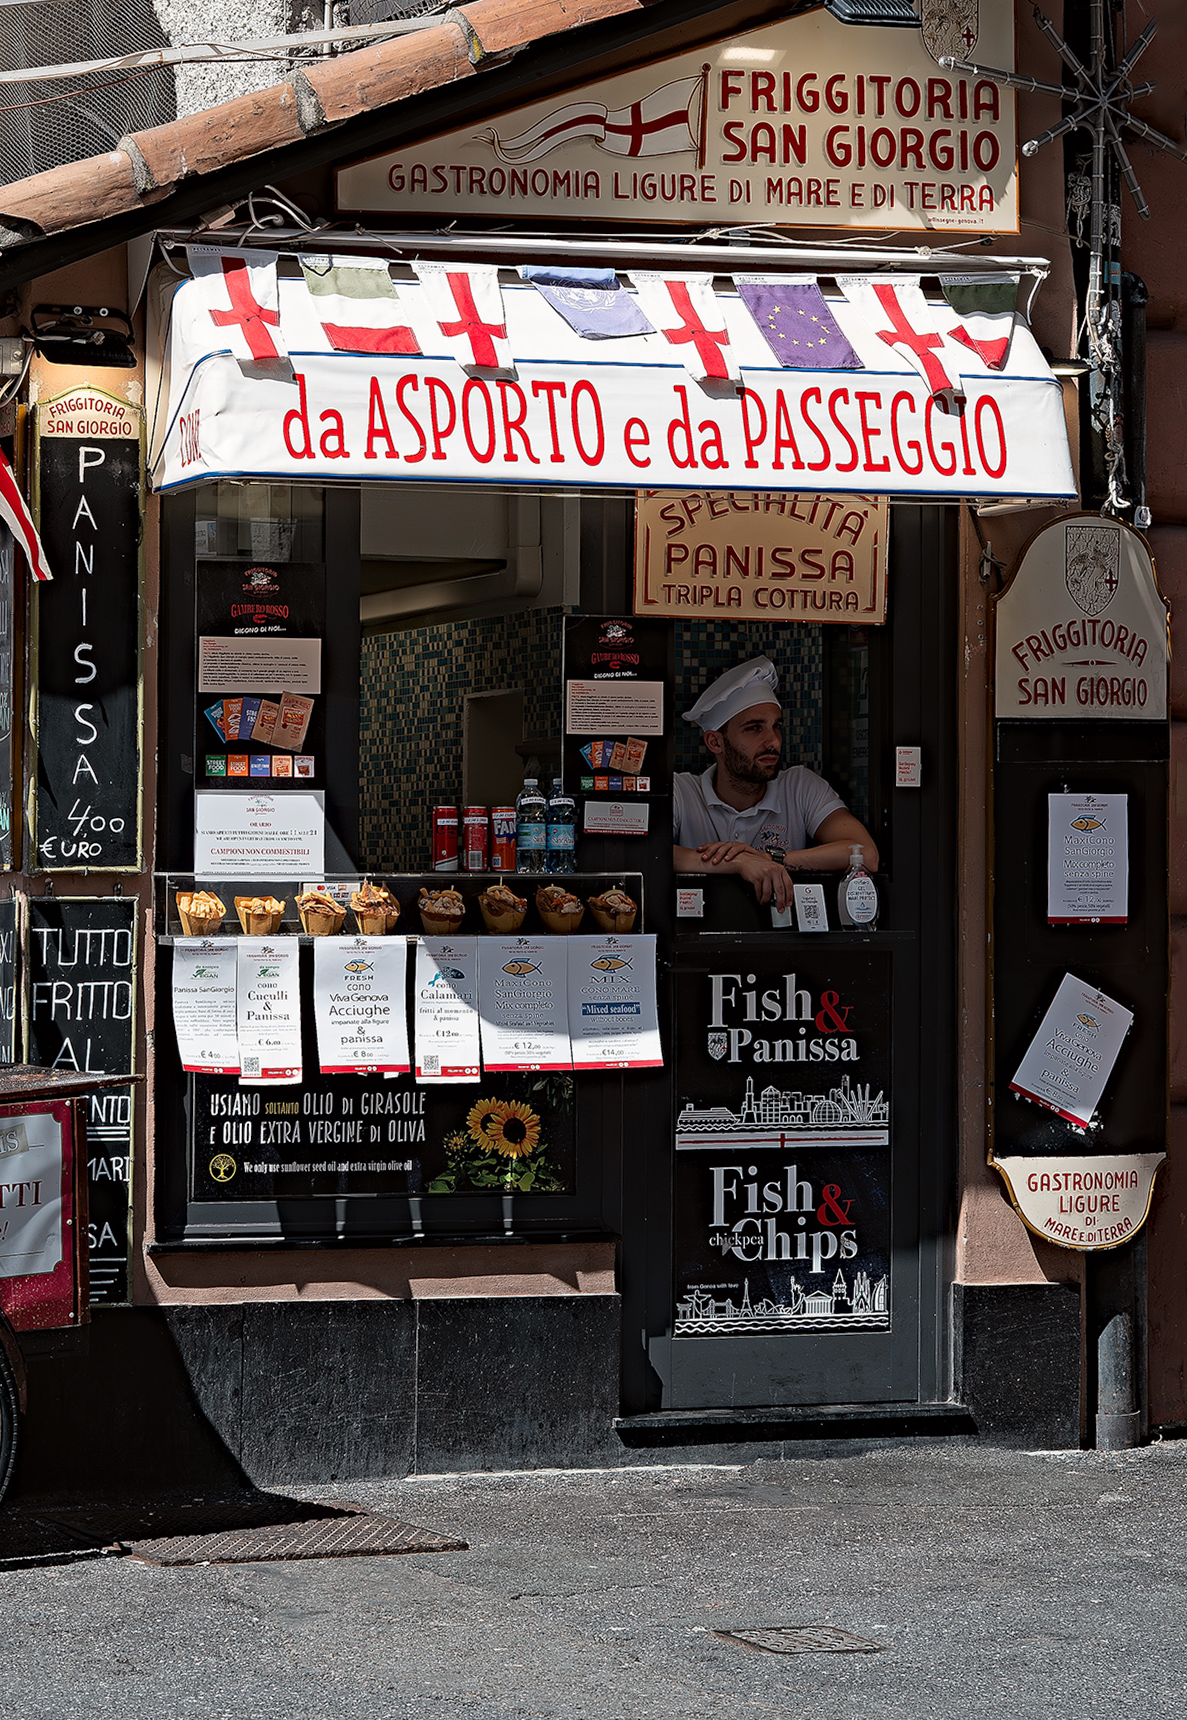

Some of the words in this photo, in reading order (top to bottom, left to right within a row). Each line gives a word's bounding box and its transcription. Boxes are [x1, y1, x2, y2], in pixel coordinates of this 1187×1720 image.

[720, 69, 1001, 122] FRIGGITORIA
[721, 121, 808, 165] SAN
[825, 124, 1001, 173] GIORGIO
[388, 163, 601, 199] GASTRONOMIA
[614, 171, 717, 203] LIGURE
[729, 177, 752, 204] DI
[766, 177, 841, 207] MARE
[851, 182, 865, 207] E
[873, 182, 896, 209] DI
[906, 181, 996, 212] TERRA
[49, 397, 126, 419] FRIGGITORIA
[47, 420, 74, 434] SAN
[77, 421, 132, 435] GIORGIO
[282, 373, 350, 459] da
[364, 373, 605, 467] ASPORTO
[623, 417, 652, 468] e
[667, 385, 729, 469] da
[738, 386, 1007, 478] PASSEGGIO
[659, 491, 869, 546] SPECIALITÀ
[664, 543, 855, 581] PANISSA
[662, 584, 743, 607] TRIPLA
[754, 587, 859, 611] COTTURA
[231, 604, 265, 618] GAMBERO
[266, 604, 289, 619] ROSSO
[1011, 619, 1148, 672] FRIGGITORIA
[591, 652, 620, 665] GAMBERO
[621, 653, 640, 666] ROSSO
[1017, 676, 1066, 705] SAN
[1076, 676, 1148, 707] GIORGIO
[1064, 836, 1115, 845] MaxiCono
[261, 848, 310, 856] COMMESTIBILI
[1064, 847, 1114, 857] SanGiorgio
[31, 928, 133, 966] TUTTO
[347, 983, 371, 991] cono
[494, 979, 552, 987] MaxiCono
[590, 975, 632, 984] MIX
[199, 986, 235, 994] SanGiorgio
[247, 990, 288, 1001] Cuculli
[329, 993, 350, 1002] Viva
[350, 993, 389, 1002] Genova
[420, 989, 472, 1000] Calamari
[494, 989, 553, 1000] SanGiorgio
[32, 982, 133, 1020] FRITTO
[263, 1001, 272, 1012] &
[495, 1001, 513, 1010] Mix
[513, 1000, 554, 1011] completo
[707, 973, 815, 1028] Fish
[815, 990, 854, 1032] &
[246, 1010, 290, 1021] Panissa
[329, 1004, 390, 1018] Acciughe
[524, 1012, 544, 1020] spine
[340, 1034, 383, 1045] panissa
[357, 1026, 366, 1035] &
[727, 1027, 860, 1063] Panissa
[1054, 1027, 1071, 1044] Viva
[1071, 1037, 1102, 1061] Genova
[51, 1037, 106, 1075] AL
[1045, 1038, 1099, 1073] Acciughe
[1041, 1069, 1080, 1094] panissa
[265, 1102, 299, 1114] SOLTANTO
[303, 1092, 333, 1115] OLIO
[343, 1098, 353, 1115] DI
[361, 1092, 426, 1115] GIRASOLE
[210, 1127, 216, 1144] E
[223, 1121, 252, 1144] OLIO
[261, 1120, 301, 1144] EXTRA
[309, 1120, 363, 1144] VERGINE
[370, 1125, 381, 1142] DI
[388, 1119, 426, 1142] OLIVA
[244, 1162, 253, 1173] We
[254, 1162, 268, 1174] only
[269, 1164, 279, 1173] use
[281, 1161, 311, 1173] sunflower
[312, 1161, 326, 1172] seed
[327, 1160, 336, 1172] oil
[337, 1160, 349, 1172] and
[350, 1161, 366, 1172] extra
[368, 1160, 386, 1173] virgin
[387, 1160, 402, 1171] olive
[403, 1160, 412, 1171] oil
[1027, 1170, 1138, 1192] GASTRONOMIA
[709, 1165, 815, 1227] Fish
[817, 1183, 856, 1226] &
[1060, 1194, 1120, 1213] LIGURE
[1044, 1217, 1079, 1241] MARE
[1079, 1231, 1085, 1242] E
[1087, 1231, 1097, 1242] DI
[1097, 1216, 1133, 1242] TERRA
[1085, 1216, 1096, 1226] DI
[709, 1231, 764, 1249] chickpea
[731, 1216, 858, 1273] Chips
